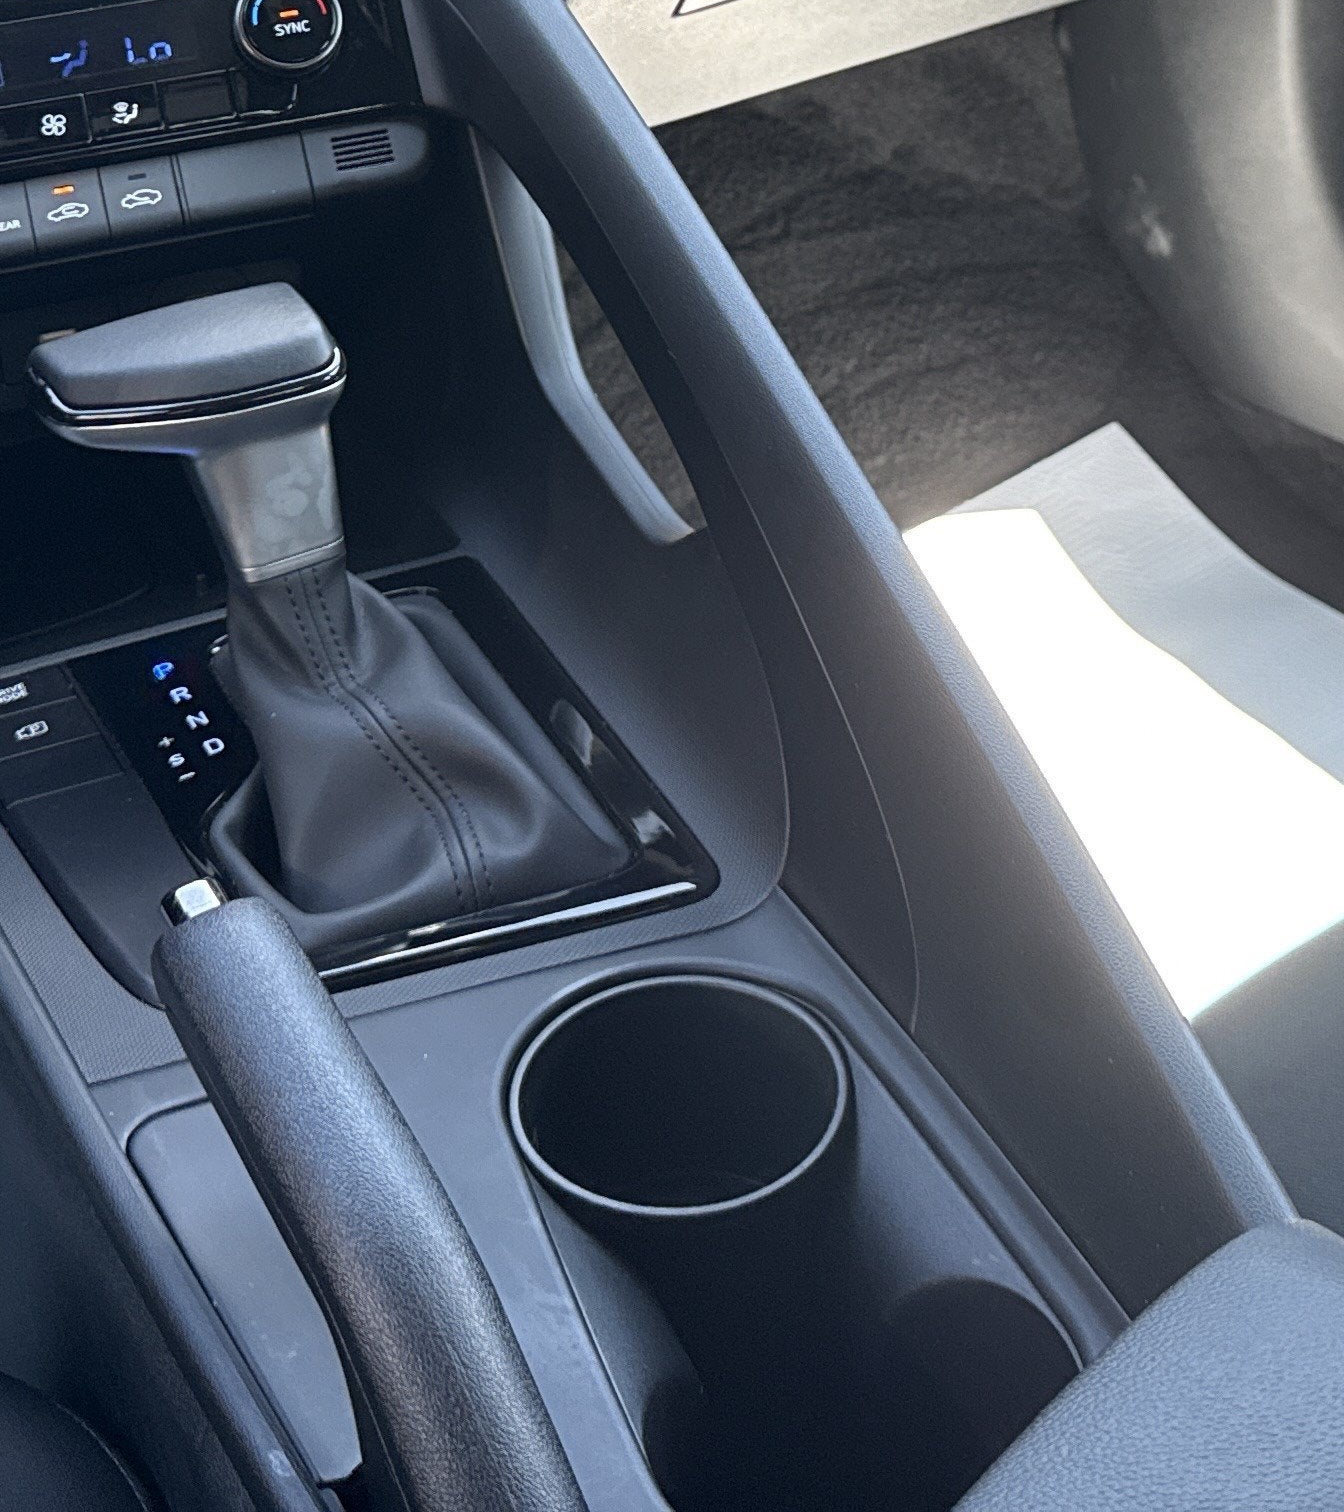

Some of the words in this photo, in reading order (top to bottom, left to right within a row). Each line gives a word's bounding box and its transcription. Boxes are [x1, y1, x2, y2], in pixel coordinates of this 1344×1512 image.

[273, 20, 312, 38] SYNC
[124, 37, 173, 65] Lo
[153, 662, 174, 680] P
[170, 687, 192, 704] R
[186, 711, 209, 730] N
[203, 738, 224, 756] D
[168, 753, 185, 767] S
